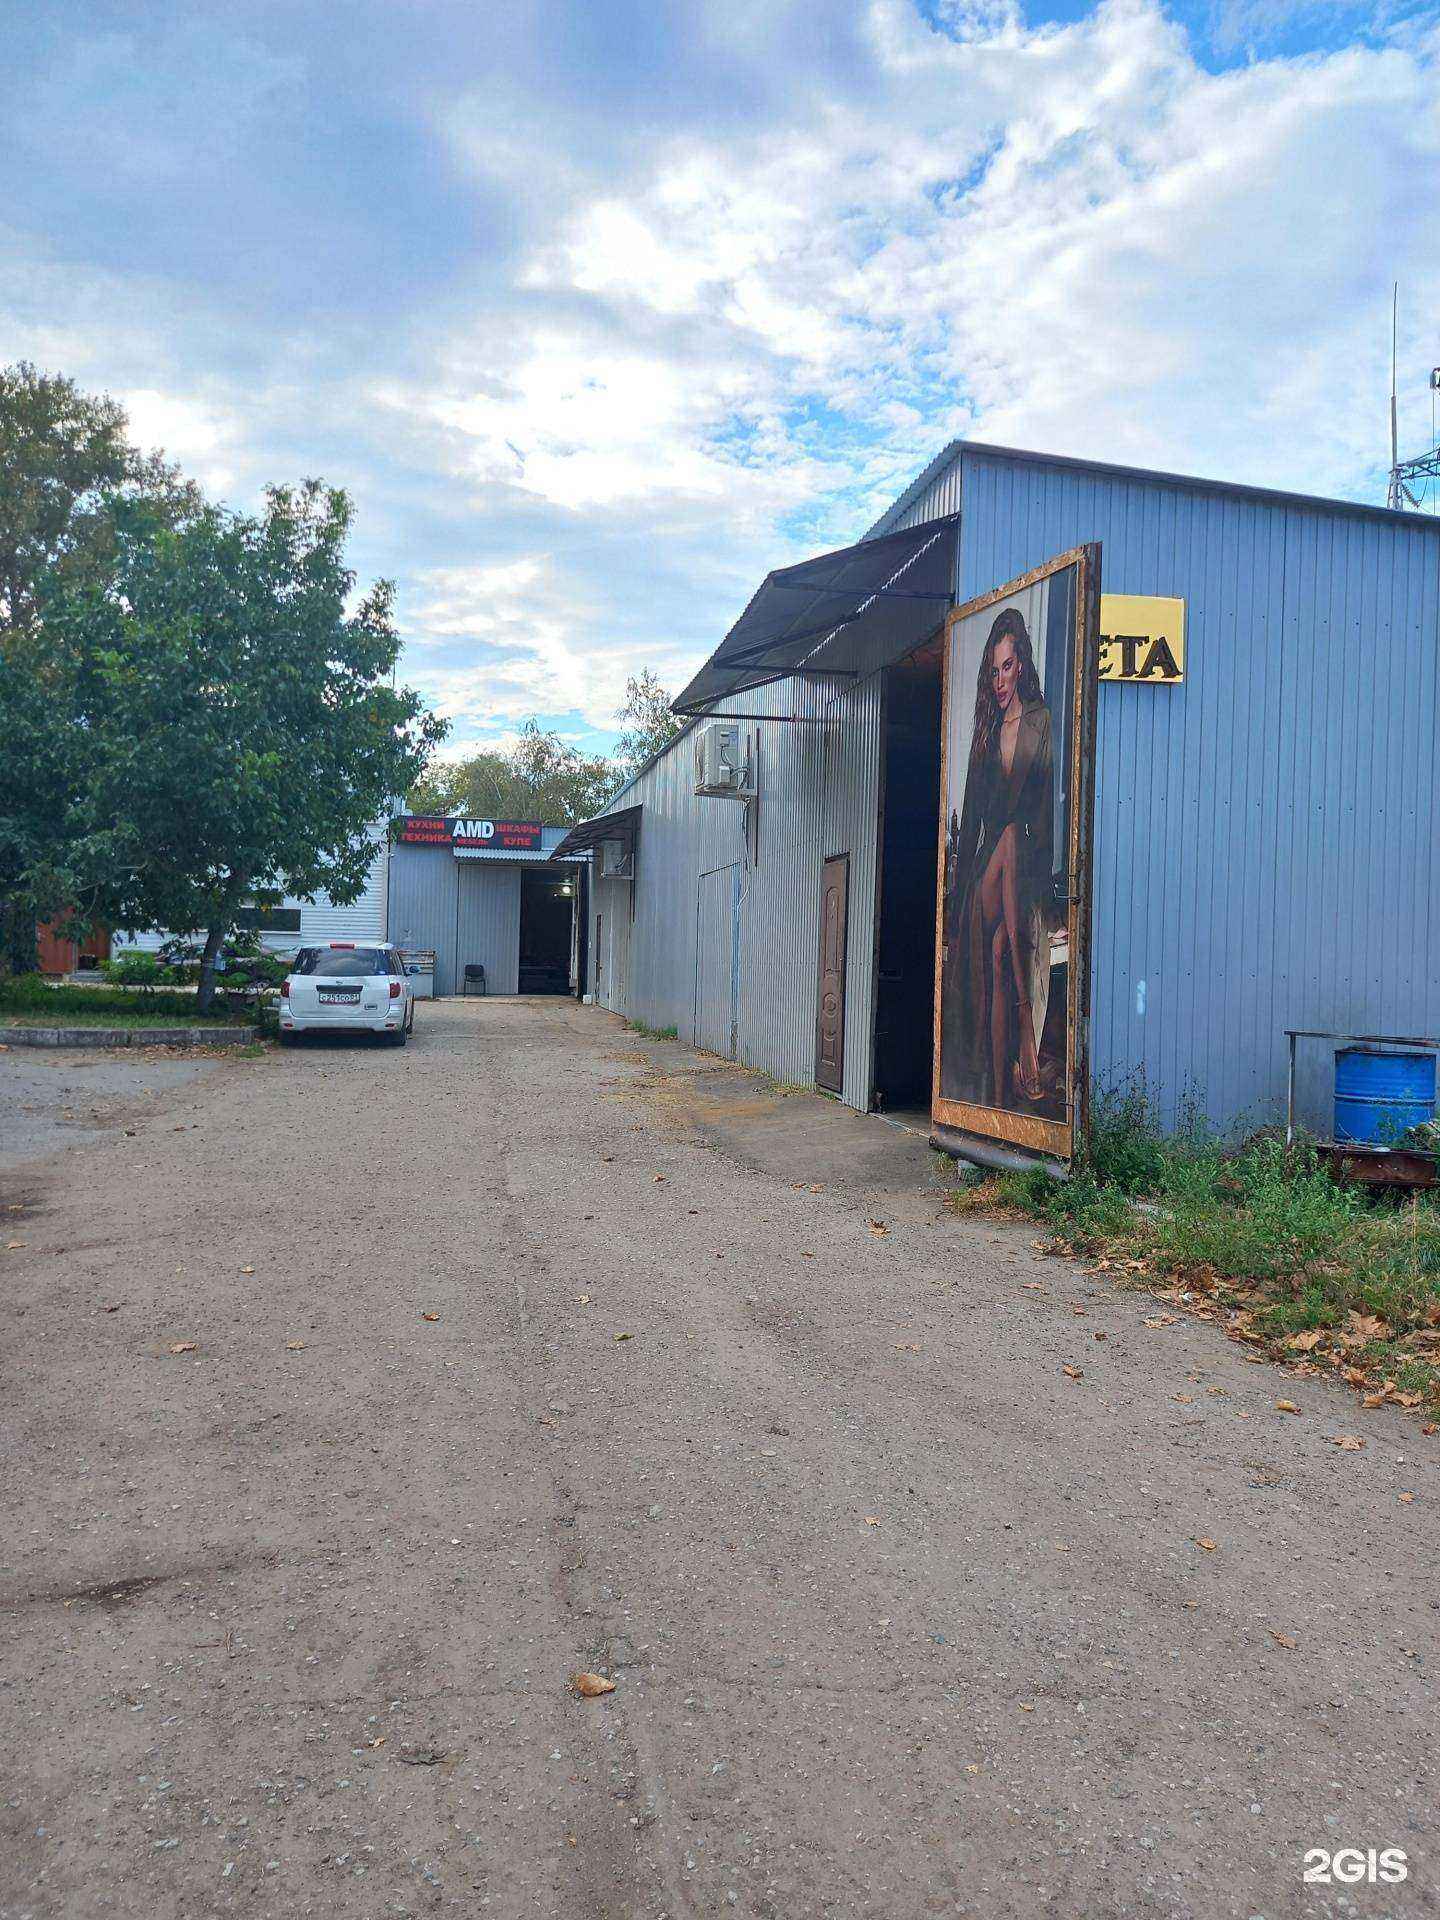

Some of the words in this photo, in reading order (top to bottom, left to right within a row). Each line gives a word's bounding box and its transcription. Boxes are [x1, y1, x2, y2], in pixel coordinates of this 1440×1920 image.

[407, 820, 445, 831] КУХНИ
[453, 820, 495, 839] AMD
[496, 824, 540, 836] ШКАФЫ
[402, 832, 452, 843] ТЕХНИКА
[504, 836, 532, 847] КУПЕ
